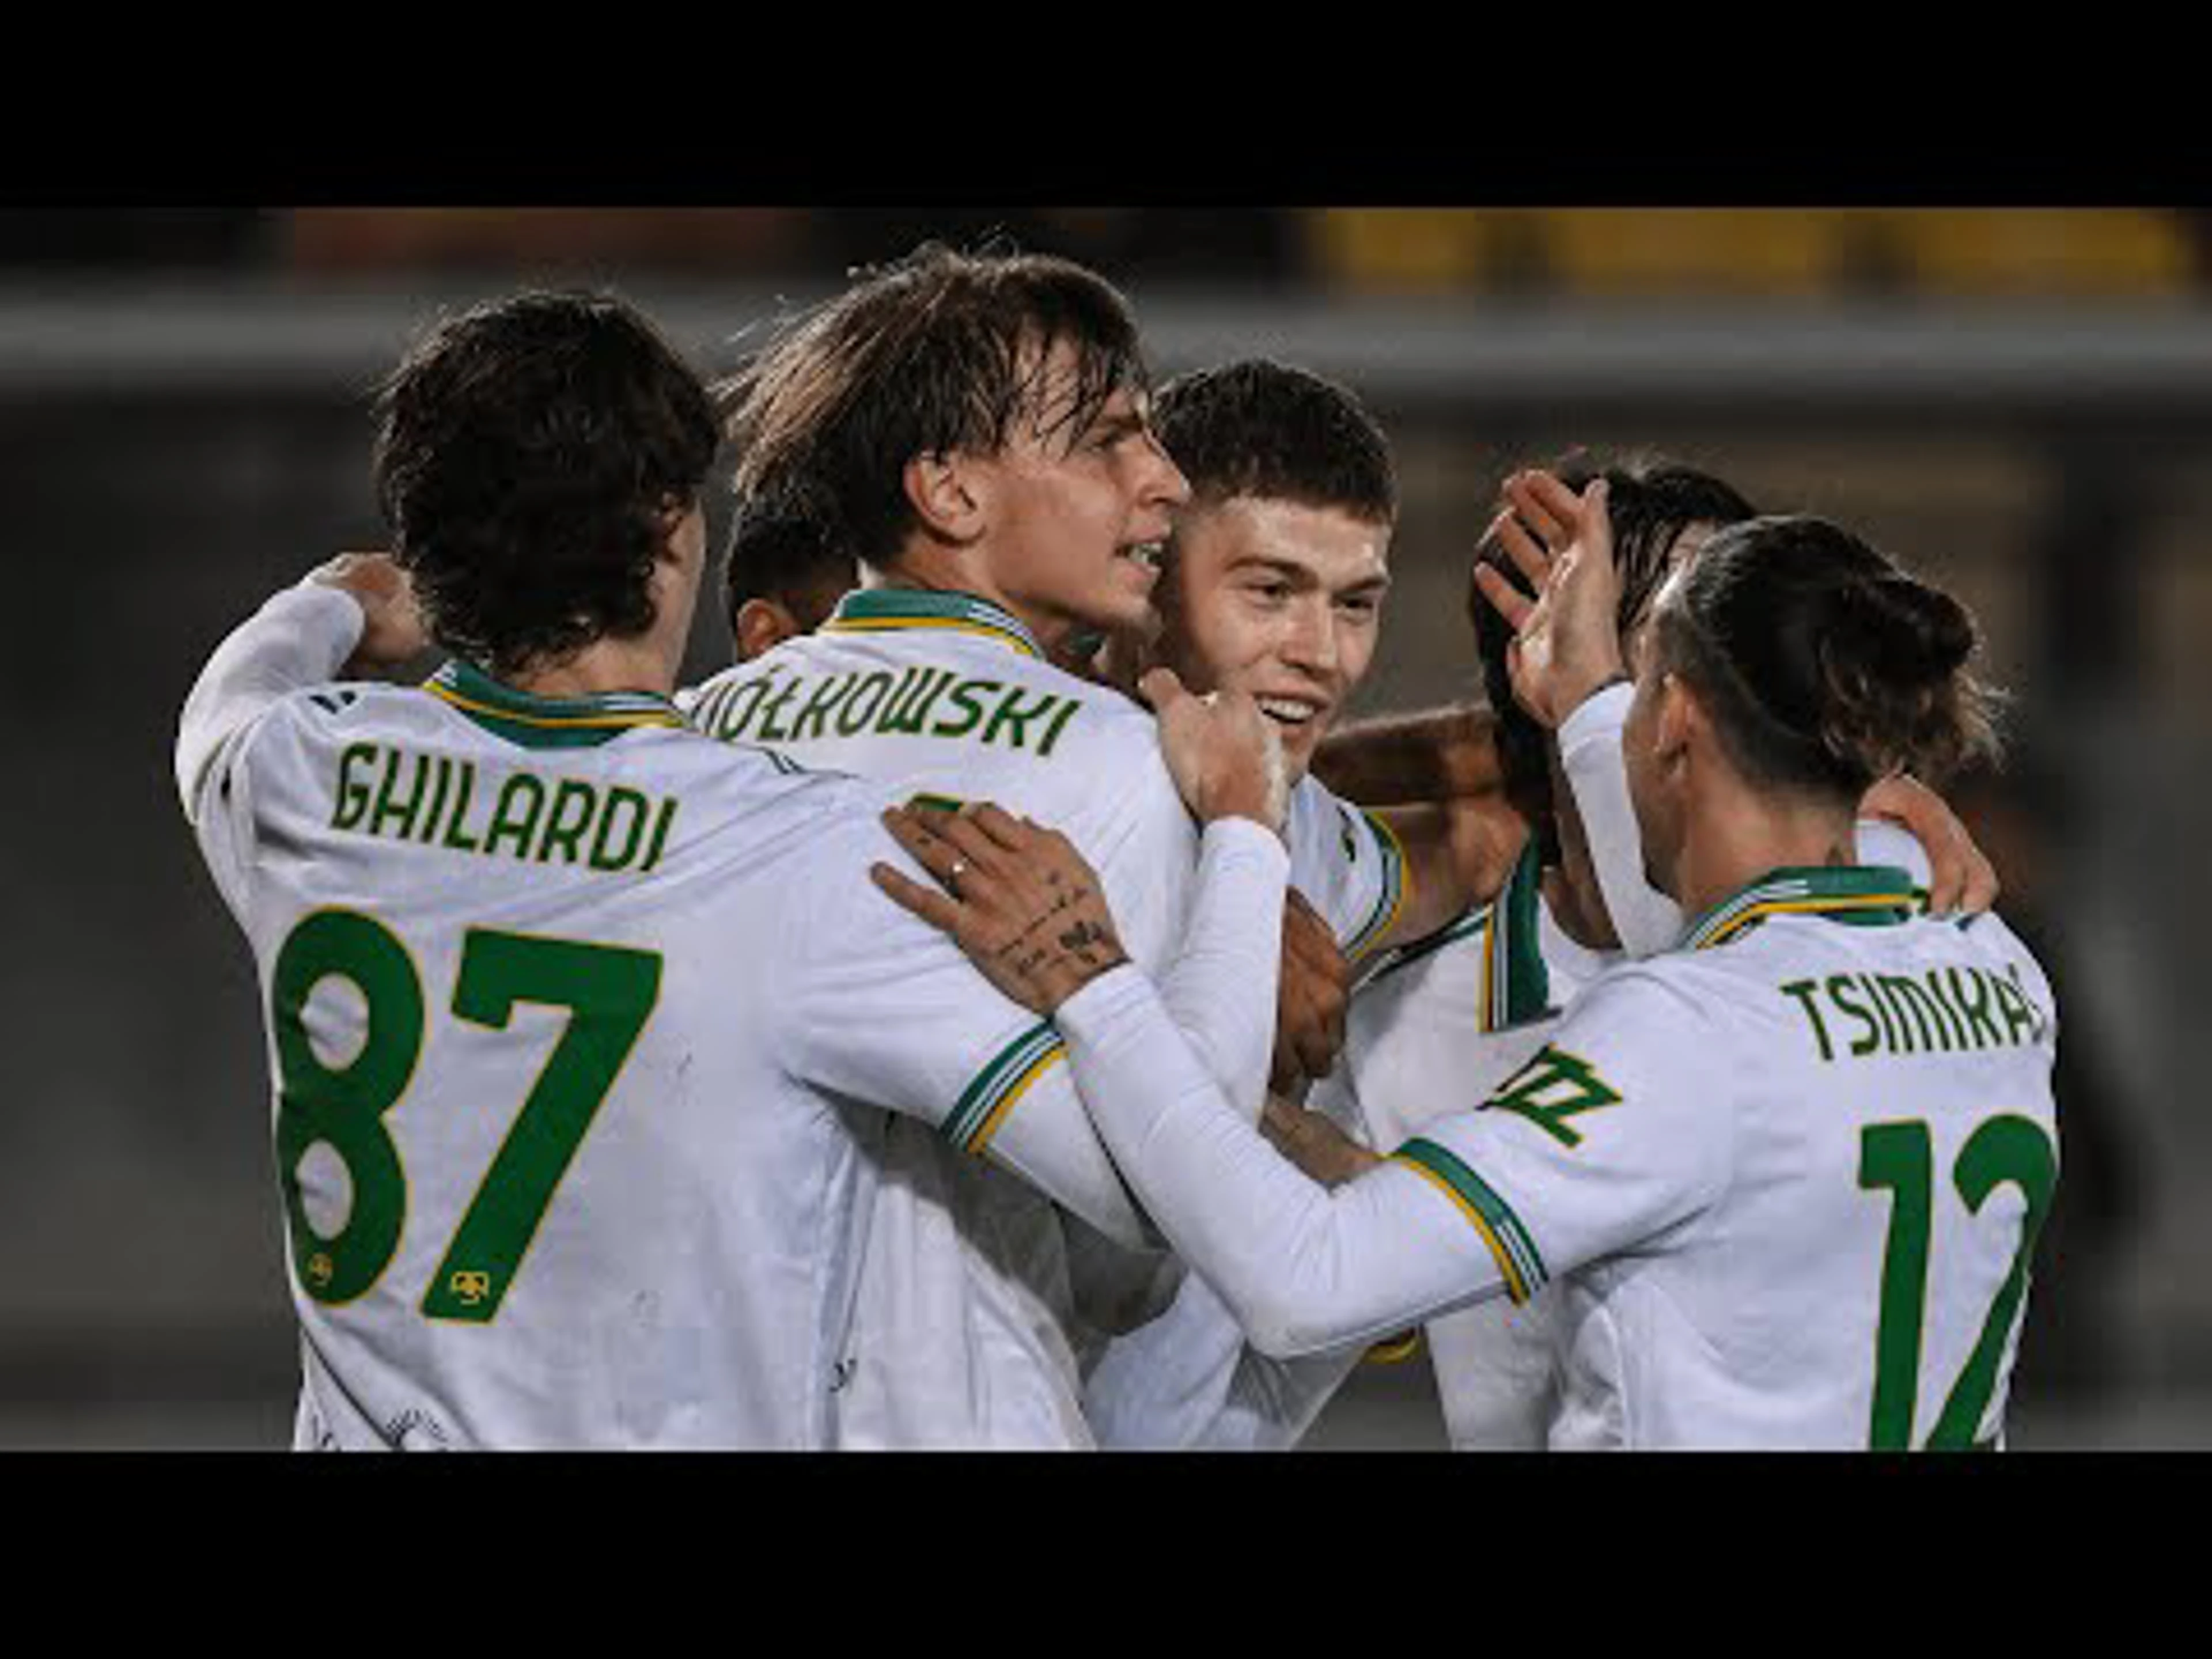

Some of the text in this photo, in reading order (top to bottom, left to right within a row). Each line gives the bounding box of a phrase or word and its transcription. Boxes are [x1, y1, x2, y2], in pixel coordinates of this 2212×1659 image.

[330, 741, 679, 872] GHILARDI
[272, 904, 664, 1324] 87
[1858, 1112, 2056, 1452] 12
